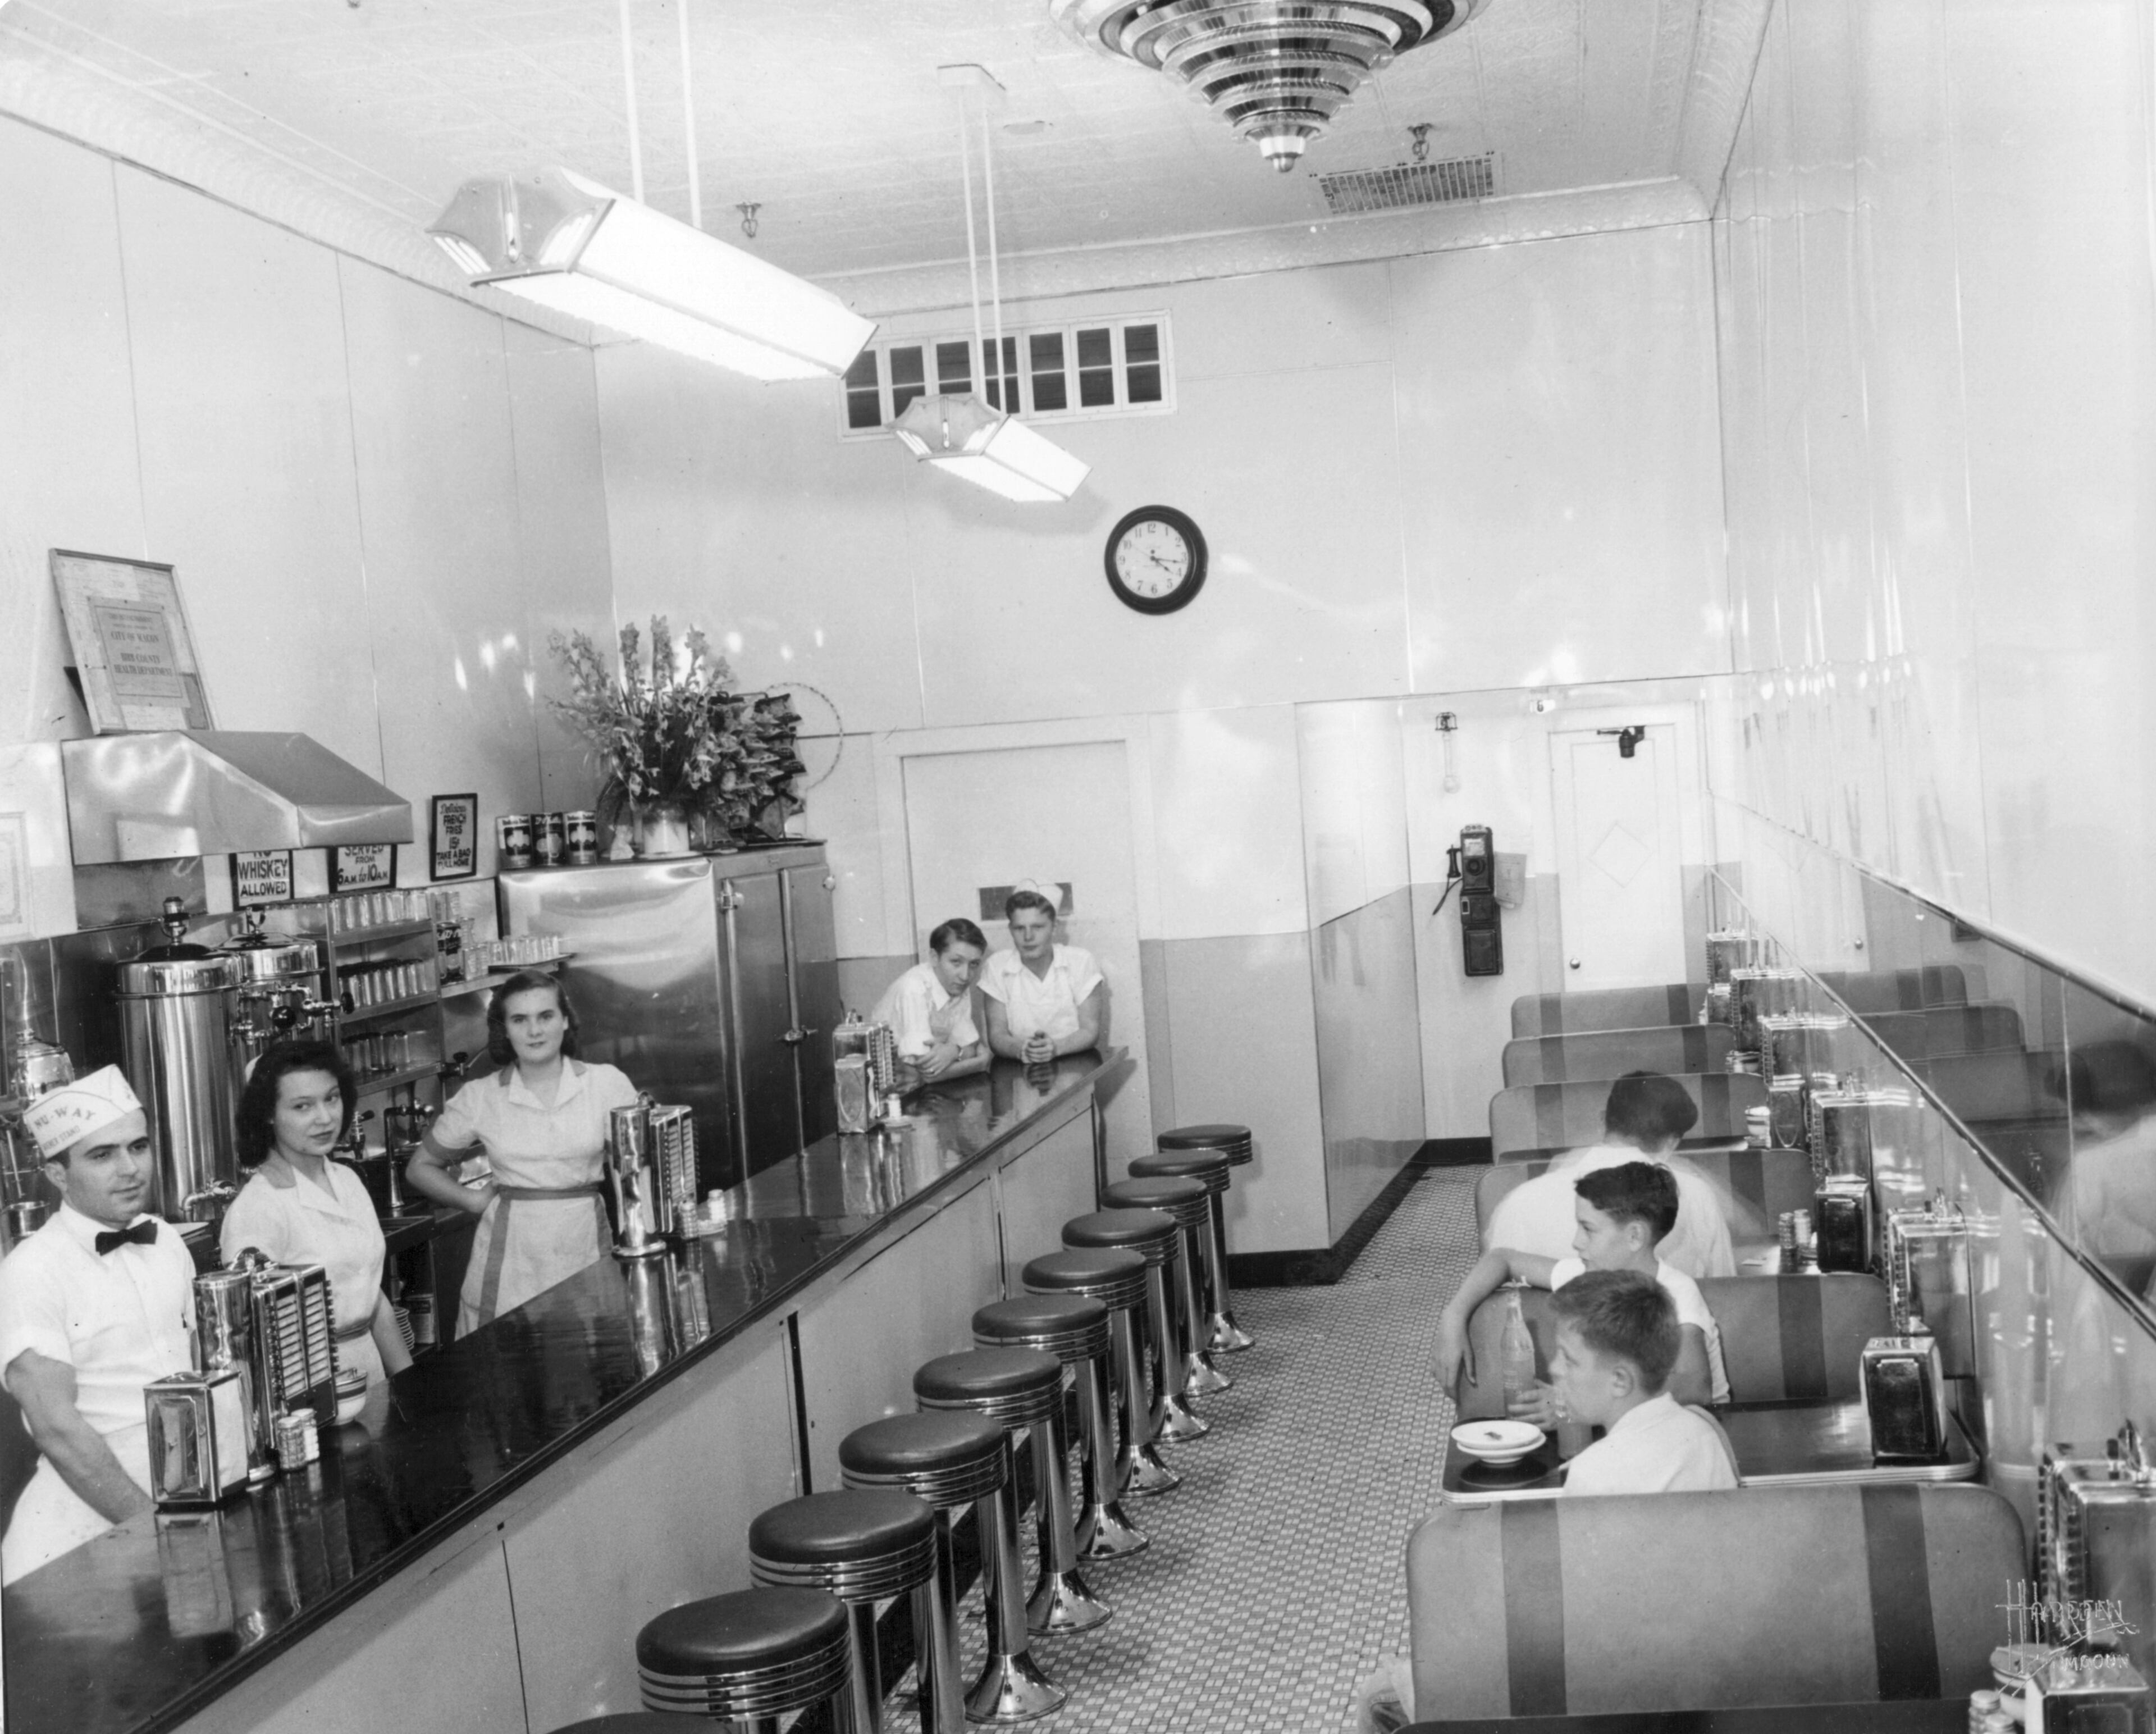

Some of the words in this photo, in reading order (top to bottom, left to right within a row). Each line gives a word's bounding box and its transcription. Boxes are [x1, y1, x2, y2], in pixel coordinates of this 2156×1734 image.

[1135, 527, 1142, 538] 11
[1147, 523, 1156, 533] 12
[1122, 540, 1132, 550] 10
[1175, 537, 1181, 547] 2
[1119, 555, 1126, 565] 9
[1125, 569, 1131, 580] 8
[1137, 579, 1144, 591] 7
[1167, 578, 1173, 588] 5
[1150, 583, 1158, 594] 6
[111, 631, 126, 641] CITY
[136, 654, 160, 664] COUNTY
[444, 813, 466, 825] FRENCH
[446, 825, 462, 835] FRIES
[355, 855, 375, 864] FROM
[437, 851, 451, 861] TAKE
[453, 850, 458, 859] A
[453, 857, 469, 867] HOME
[238, 859, 287, 879] WHISKEY
[358, 866, 367, 883] to
[240, 880, 286, 897] ALLOWED
[34, 1106, 96, 1130] NU-WAY
